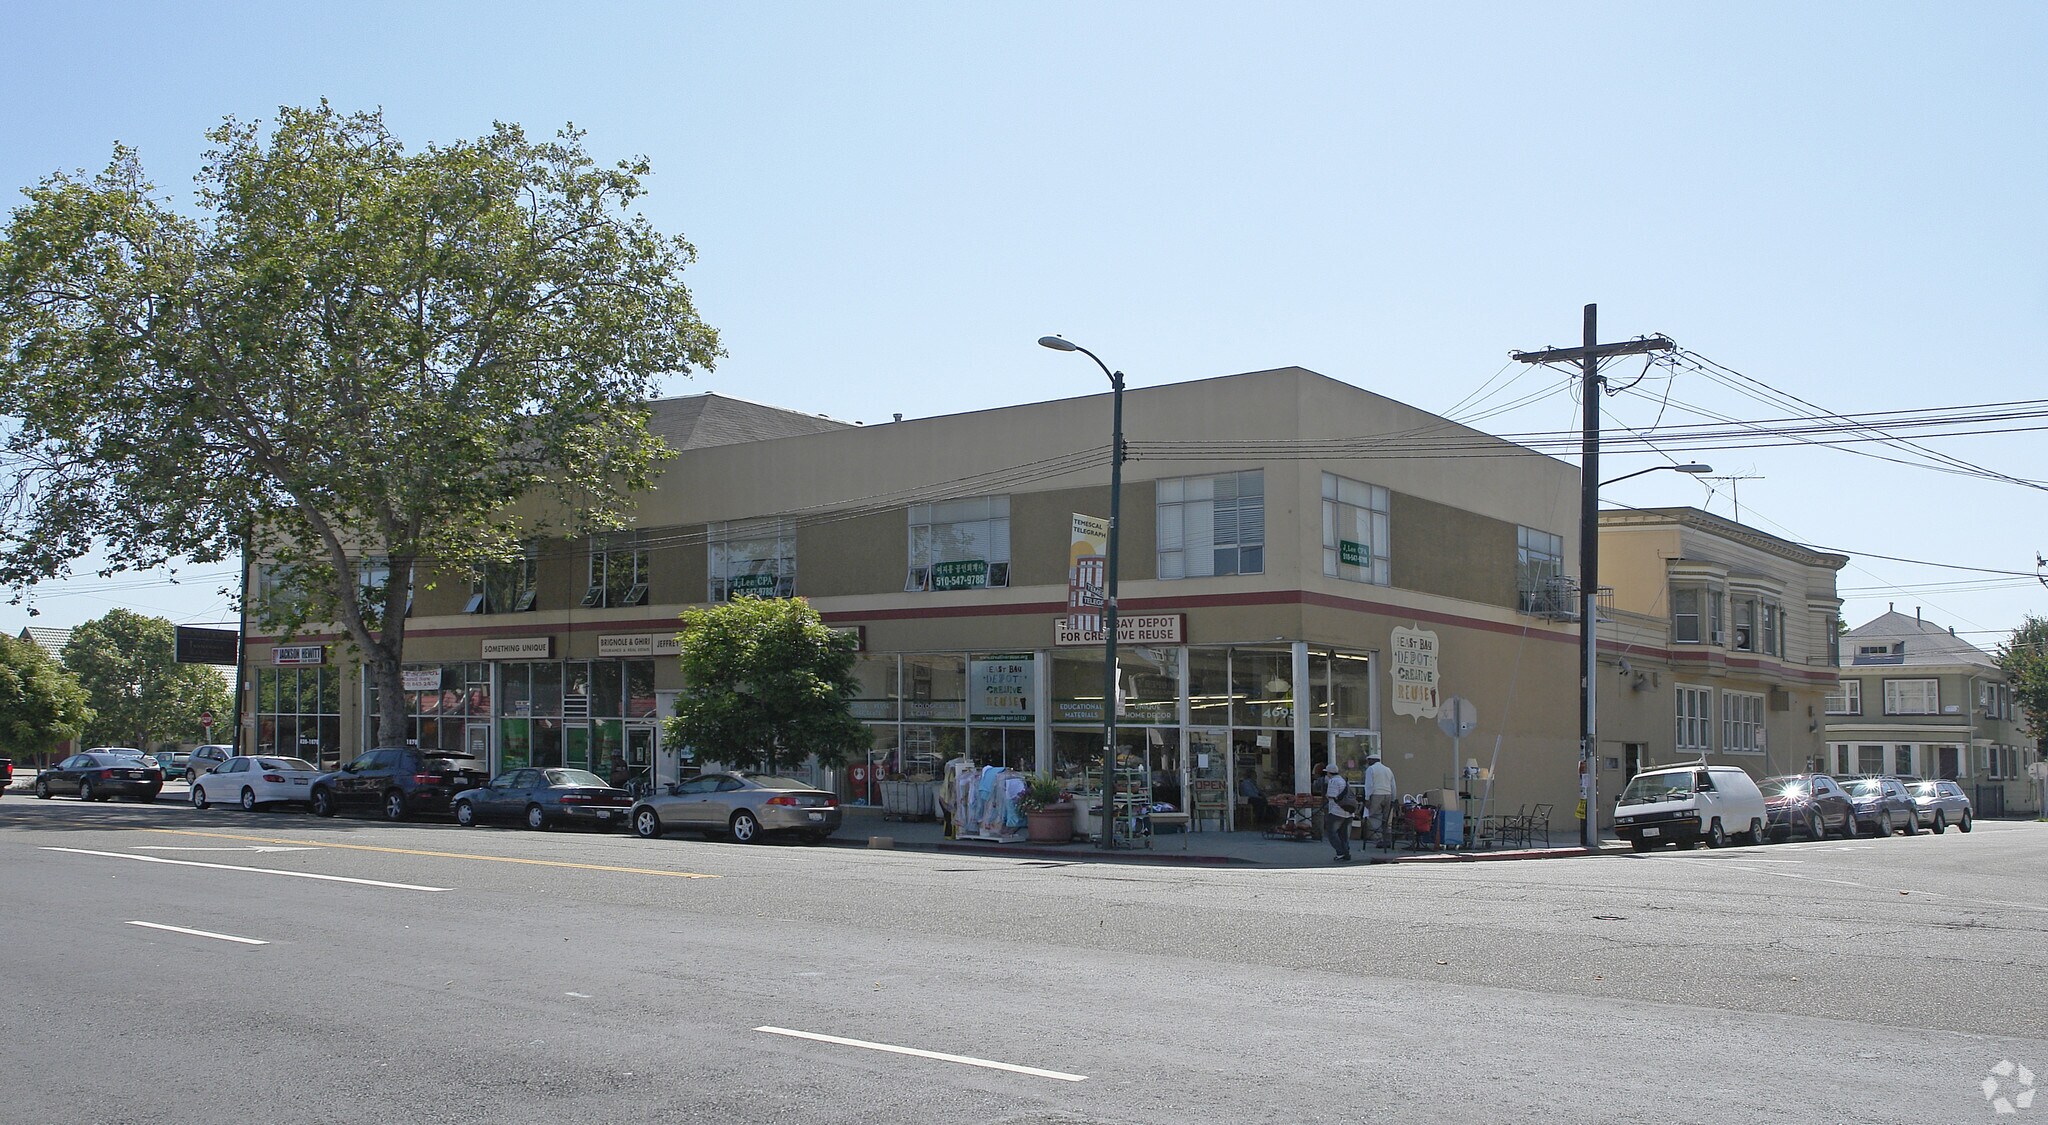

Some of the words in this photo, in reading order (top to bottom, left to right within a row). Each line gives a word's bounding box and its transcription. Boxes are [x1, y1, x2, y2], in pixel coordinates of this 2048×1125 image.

[1073, 518, 1103, 530] TEMESCAL
[1073, 526, 1106, 538] TELEGRAPH
[757, 575, 773, 586] CPA
[936, 574, 985, 586] 510-547-9788
[1138, 617, 1174, 628] DEPOT
[1060, 632, 1080, 641] FOR
[1084, 629, 1135, 641] CREIVE
[1138, 629, 1174, 640] REUSE
[484, 644, 520, 653] SOMETHING
[522, 643, 547, 652] UNIQUE
[600, 638, 628, 647] BRIGNOLE
[628, 638, 634, 646] &
[279, 648, 300, 659] JACKSON
[301, 647, 320, 658] HEWITT
[1397, 650, 1430, 666] DEPOT
[986, 674, 1019, 684] DEPOT
[1397, 667, 1433, 682] CREATIVE
[1397, 685, 1429, 701] REUSE
[1065, 711, 1099, 719] MATERIALS
[1263, 708, 1294, 719] 4695
[1195, 780, 1226, 790] OPEN
